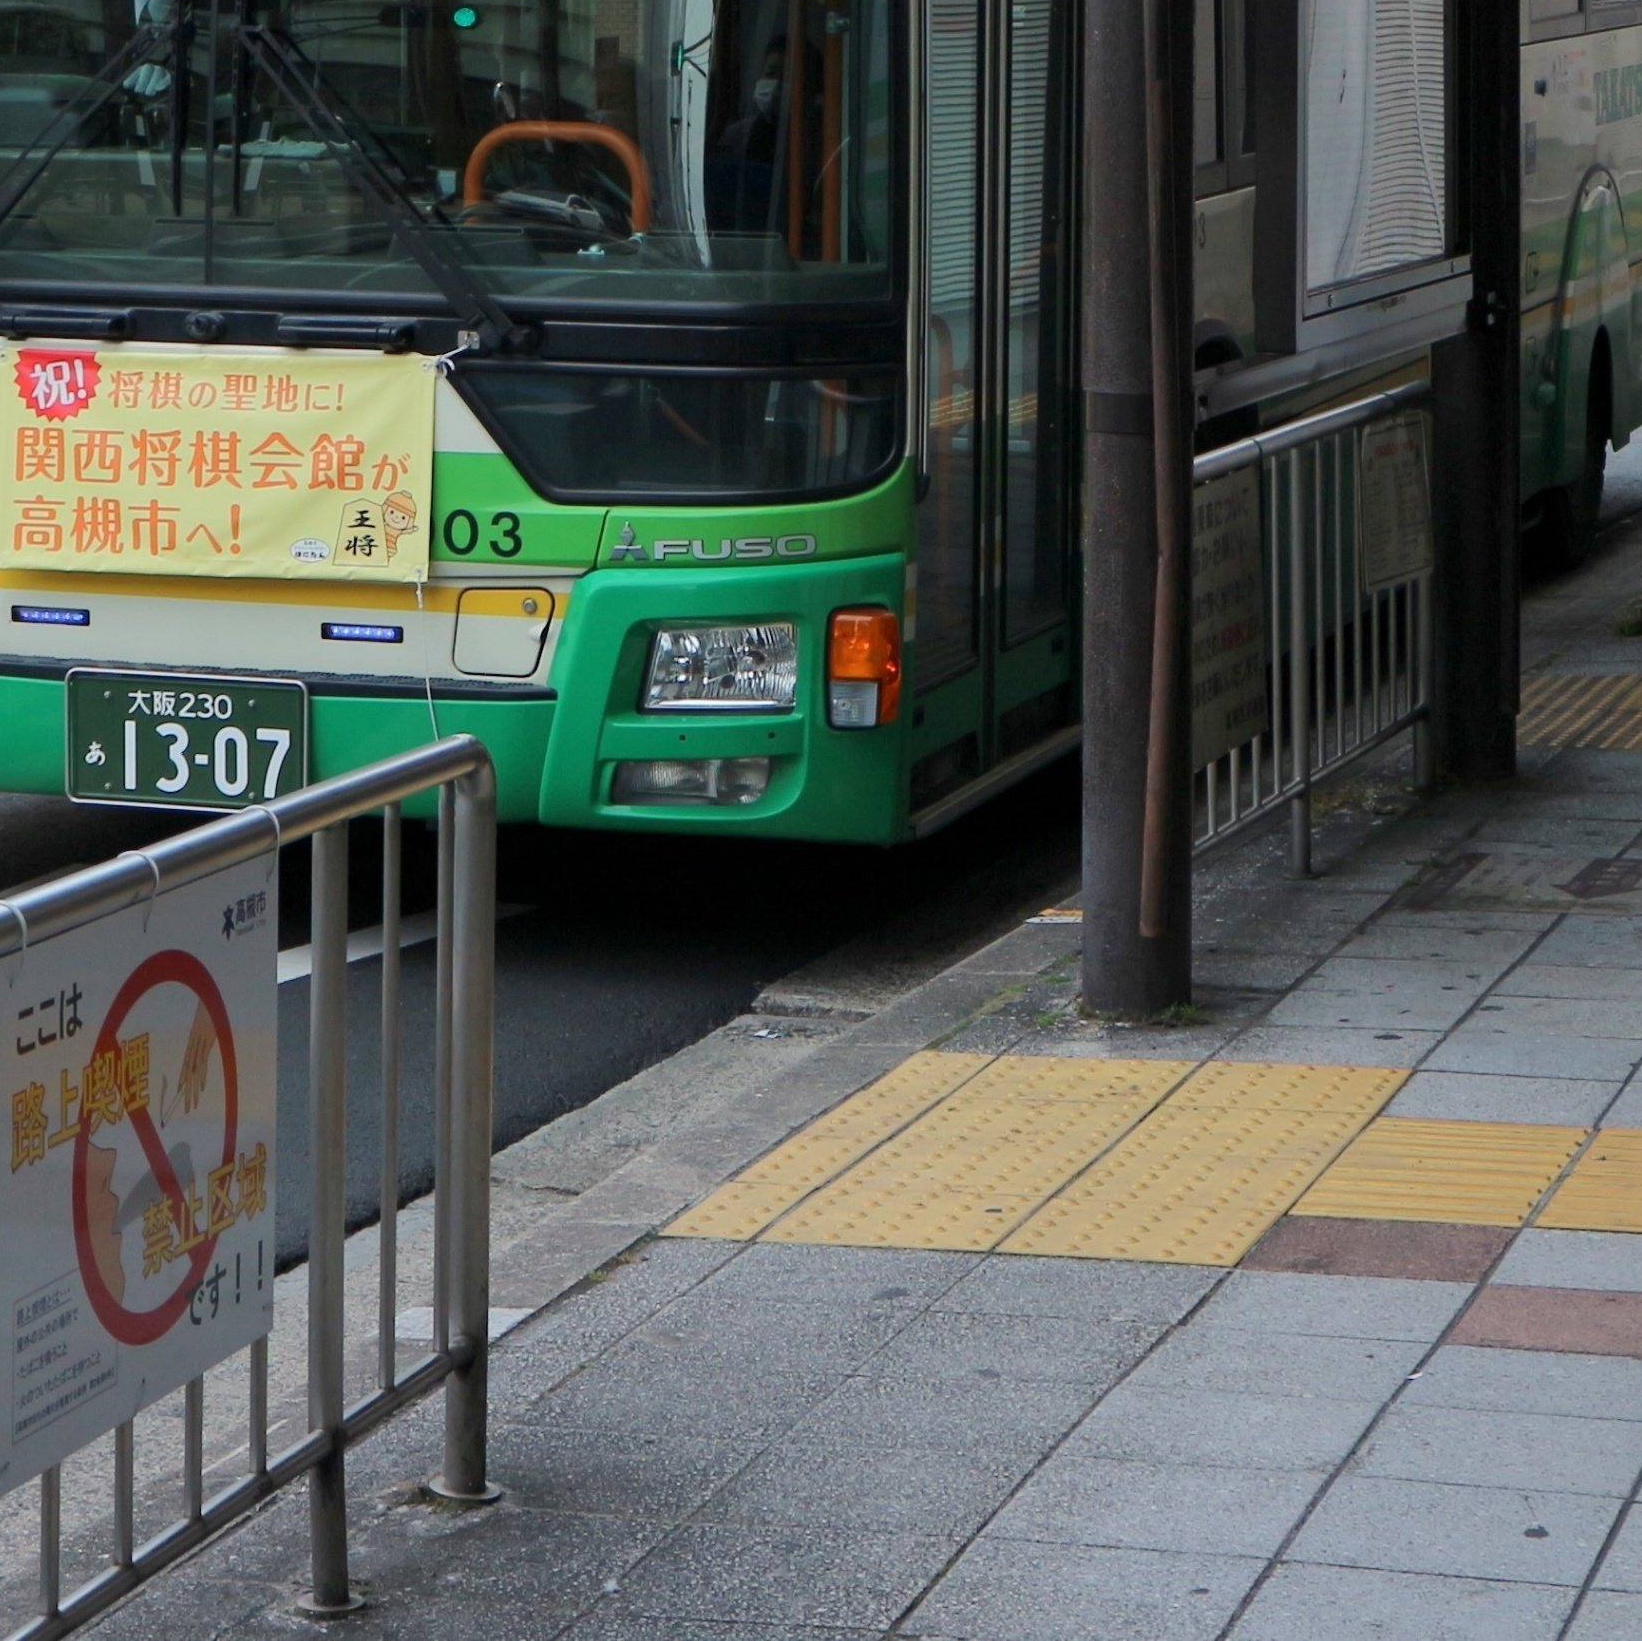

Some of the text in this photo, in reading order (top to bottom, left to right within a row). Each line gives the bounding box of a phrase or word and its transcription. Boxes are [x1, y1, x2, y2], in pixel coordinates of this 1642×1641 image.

[107, 370, 345, 413] 将棋の聖地に!
[14, 426, 412, 493] 関西将棋会館が
[12, 494, 243, 557] 高槻市へ!
[344, 509, 379, 557] 王将
[653, 533, 817, 561] FUSO
[84, 719, 291, 799] あ 13-07
[235, 889, 267, 928] 高槻市
[15, 982, 84, 1056] ここは
[10, 1031, 150, 1174] 路上喫煙
[142, 1142, 268, 1280] 禁止区域
